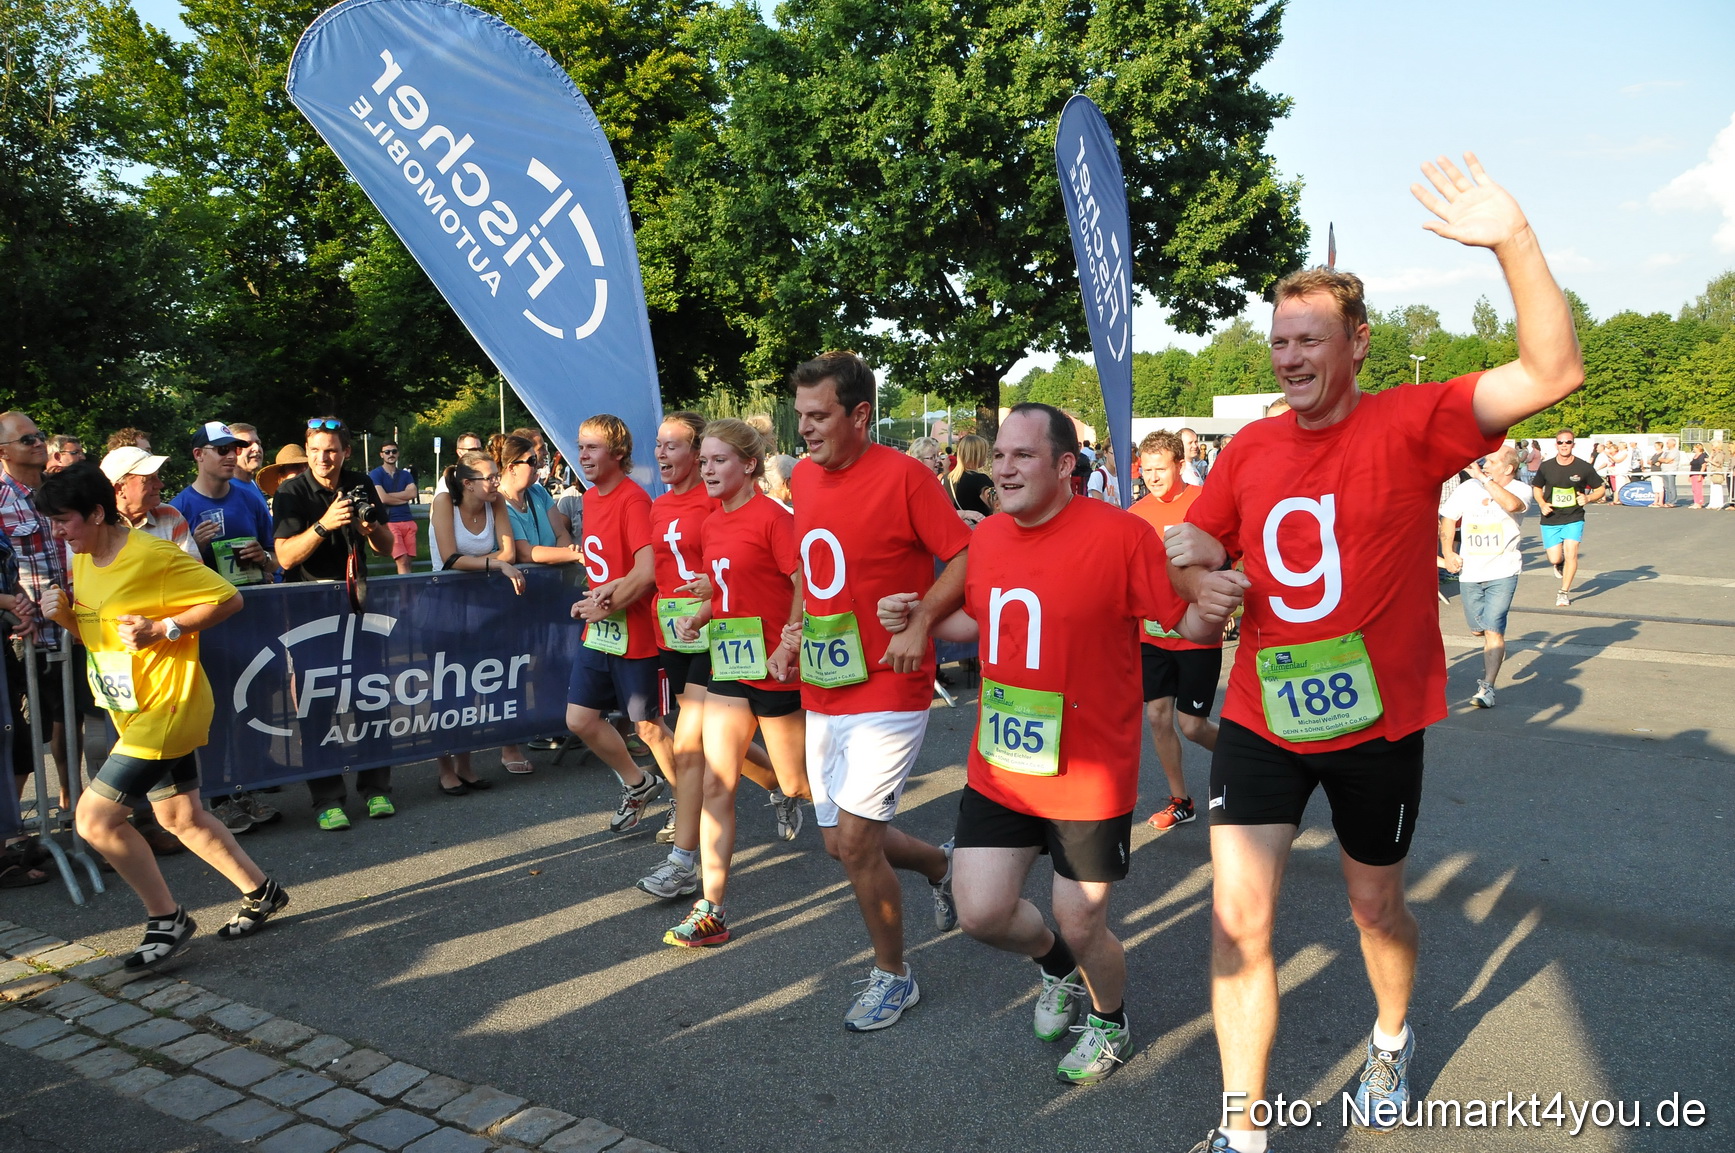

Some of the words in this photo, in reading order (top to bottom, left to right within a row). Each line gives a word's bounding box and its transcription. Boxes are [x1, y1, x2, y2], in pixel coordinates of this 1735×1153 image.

[1555, 494, 1572, 503] 320
[663, 518, 698, 581] t
[1263, 493, 1342, 623] g
[1468, 534, 1499, 547] 1011
[711, 557, 730, 612] r
[593, 620, 622, 641] 173
[988, 587, 1042, 669] n
[717, 639, 755, 664] 171
[803, 638, 850, 670] 176
[1270, 659, 1308, 672] firmenlauf
[296, 652, 531, 719] Fischer
[1277, 672, 1359, 718] 188
[320, 699, 517, 746] AUTOMOBILE
[988, 711, 1044, 754] 165
[1298, 717, 1322, 726] Michael
[1304, 725, 1325, 733] SÖHNE
[1325, 721, 1344, 731] GmbH
